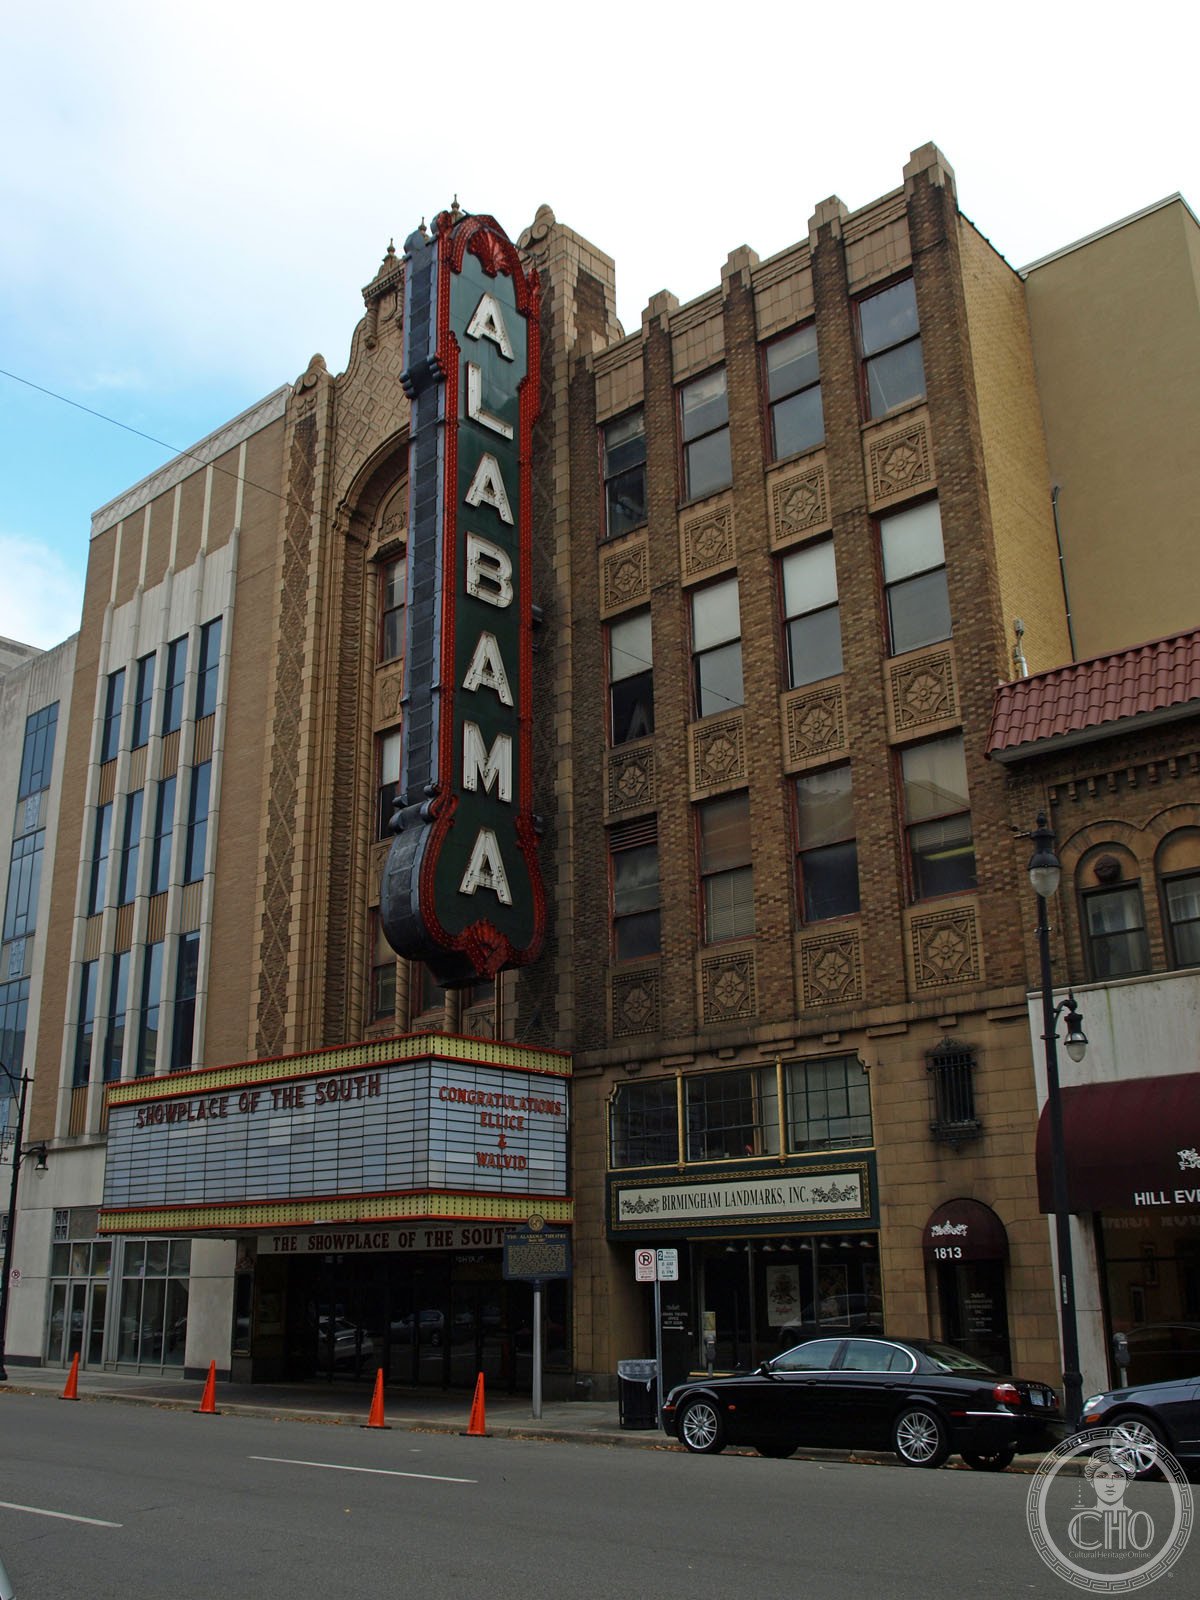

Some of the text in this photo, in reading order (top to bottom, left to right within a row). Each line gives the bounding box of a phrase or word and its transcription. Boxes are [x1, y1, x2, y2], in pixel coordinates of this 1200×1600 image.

[458, 291, 515, 906] ALABAMA
[136, 1072, 381, 1128] SHOWPLACE OF THE SOUTH
[438, 1085, 563, 1116] CONGRATULATIONS
[479, 1111, 526, 1131] ELLICE
[497, 1133, 507, 1150] &
[476, 1151, 527, 1171] WALVID
[661, 1186, 809, 1211] BIRMINGHAM LANDMARKS, INC.
[1134, 1191, 1171, 1206] HILL
[273, 1227, 517, 1252] THE SHOWPLACE OF THE SOUT
[934, 1247, 962, 1259] 1813
